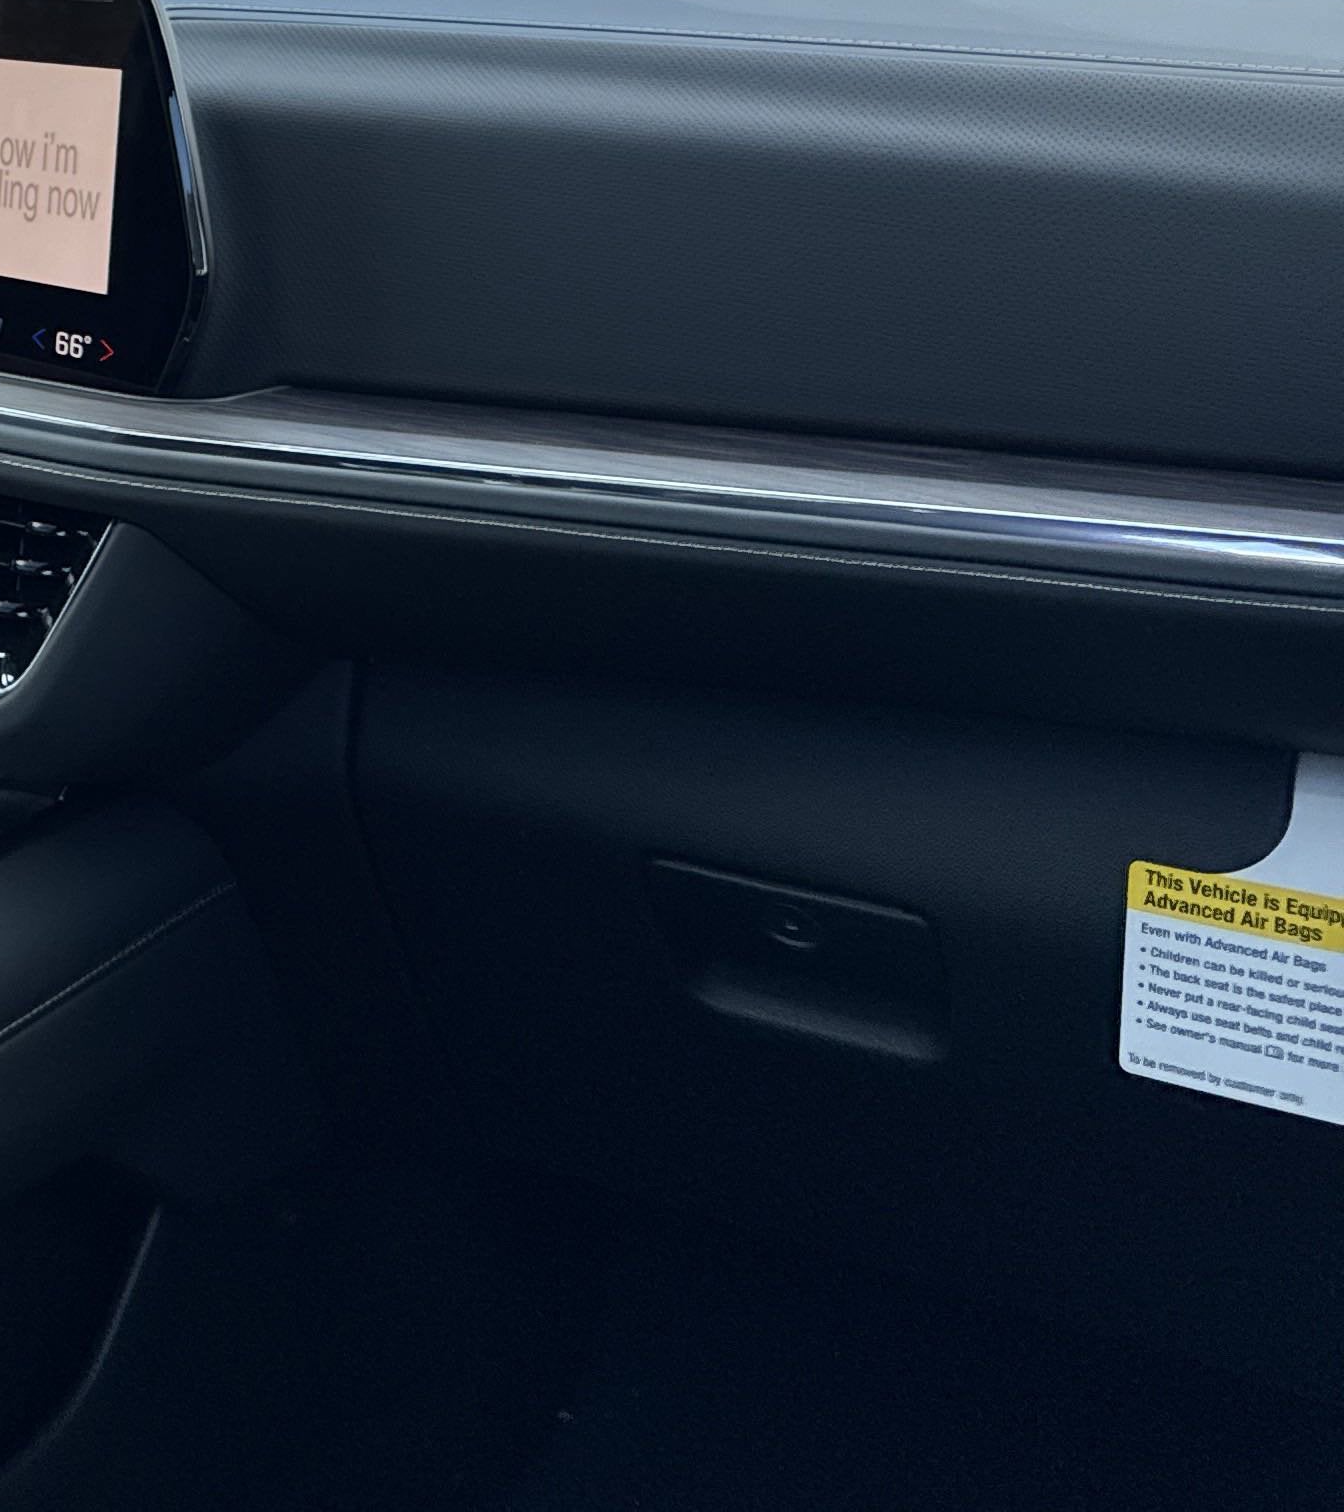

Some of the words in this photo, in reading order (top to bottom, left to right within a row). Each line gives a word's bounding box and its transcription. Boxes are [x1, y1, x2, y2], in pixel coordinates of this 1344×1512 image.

[42, 132, 78, 175] i'm
[47, 183, 101, 221] now
[55, 331, 92, 360] 66°
[1145, 869, 1184, 891] This
[1189, 878, 1257, 908] Vehicle
[1264, 893, 1280, 911] is
[1143, 890, 1235, 923] Advanced
[1240, 910, 1269, 929] Air
[1274, 916, 1323, 942] Bags
[1141, 922, 1171, 939] Even
[1174, 931, 1201, 946] with
[1205, 937, 1268, 960] Advanced
[1271, 950, 1290, 964] Air
[1150, 947, 1200, 967] Children
[1203, 960, 1226, 972] can
[1229, 963, 1245, 977] be
[1248, 968, 1283, 985] killed
[1286, 978, 1300, 988] or
[1148, 982, 1182, 999] Never
[1184, 992, 1204, 1005] put
[1206, 997, 1214, 1007] a
[1217, 1000, 1284, 1025] rear-facing
[1286, 1015, 1316, 1030] child
[1149, 963, 1170, 978] The
[1173, 970, 1201, 985] back
[1204, 979, 1230, 992] seat
[1233, 983, 1243, 995] is
[1246, 986, 1265, 1000] the
[1269, 993, 1305, 1008] safest
[1309, 1001, 1343, 1017] place
[1146, 1018, 1167, 1032] See
[1170, 1026, 1216, 1044] owner's
[1287, 1050, 1305, 1064] for
[1147, 1001, 1189, 1019] Always
[1191, 1012, 1213, 1025] use
[1215, 1018, 1241, 1032] seat
[1243, 1023, 1273, 1039] belts
[1276, 1032, 1300, 1045] and
[1128, 1050, 1141, 1065] To
[1143, 1056, 1156, 1069] be
